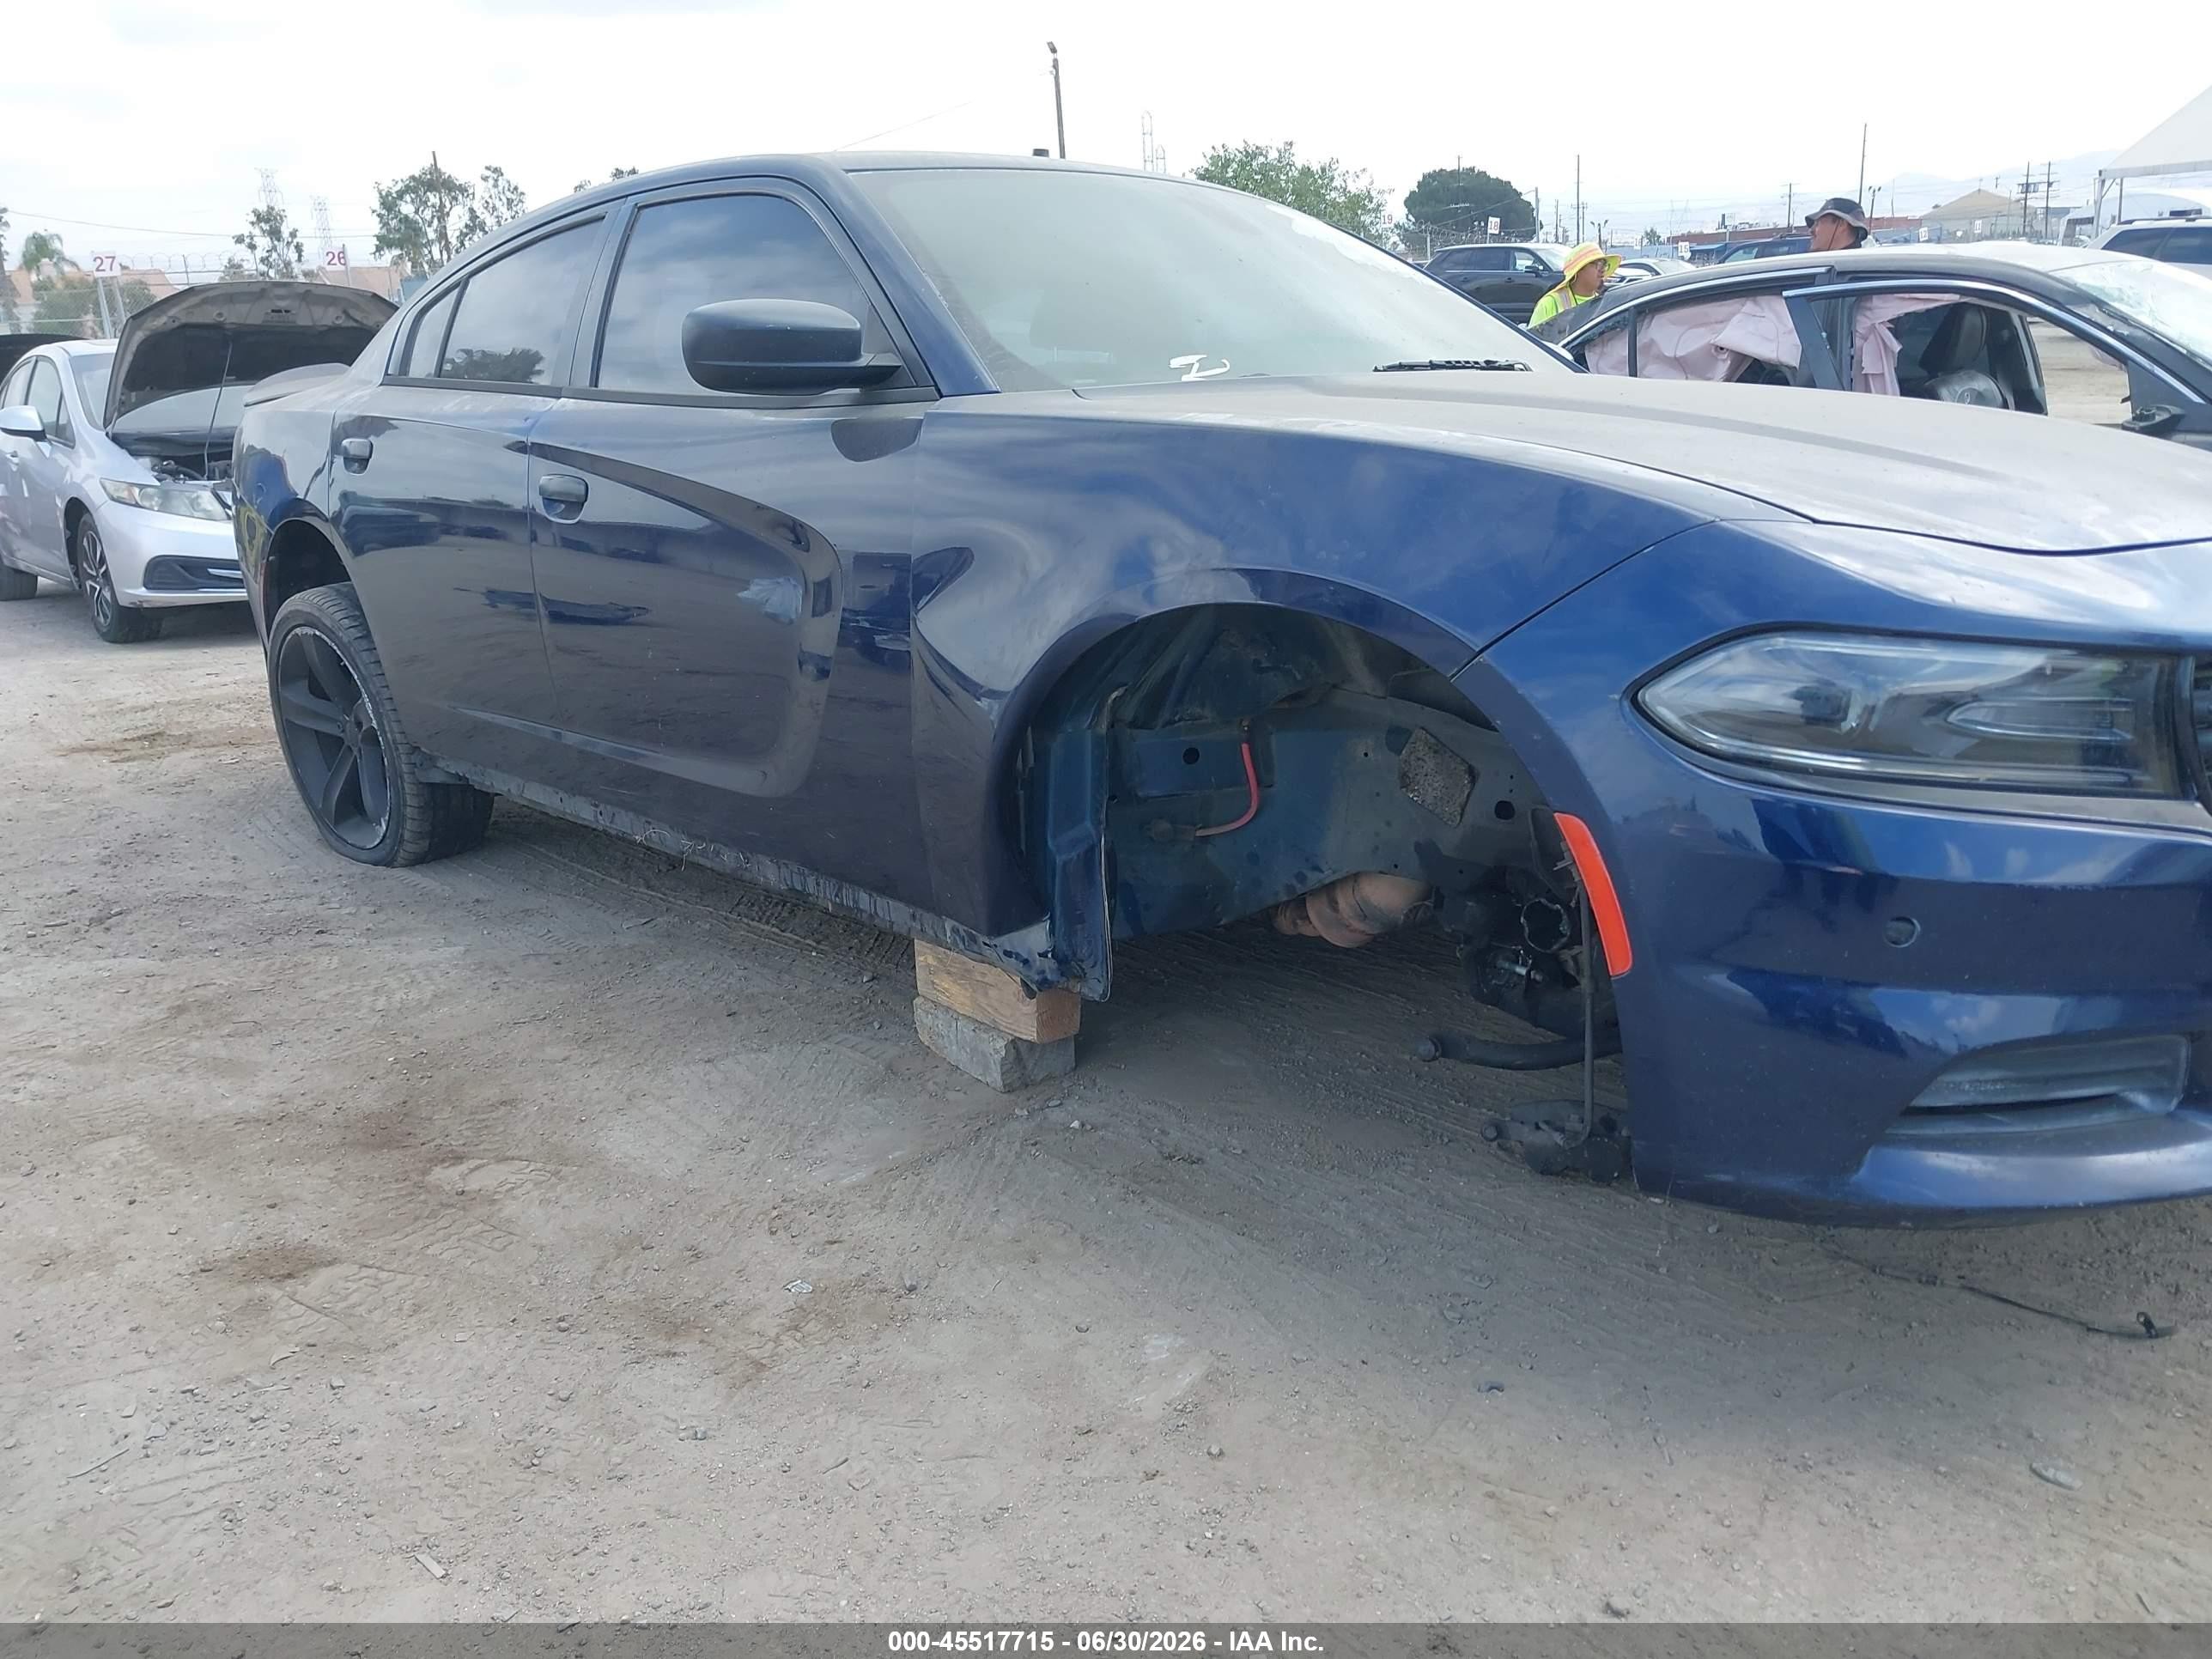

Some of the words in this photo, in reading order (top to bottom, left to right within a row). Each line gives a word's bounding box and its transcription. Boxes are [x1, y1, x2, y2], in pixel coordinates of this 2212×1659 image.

[1382, 214, 1393, 225] 19
[1490, 220, 1498, 231] 18
[1680, 244, 1689, 253] 15
[93, 256, 116, 272] 27
[325, 251, 347, 266] 26
